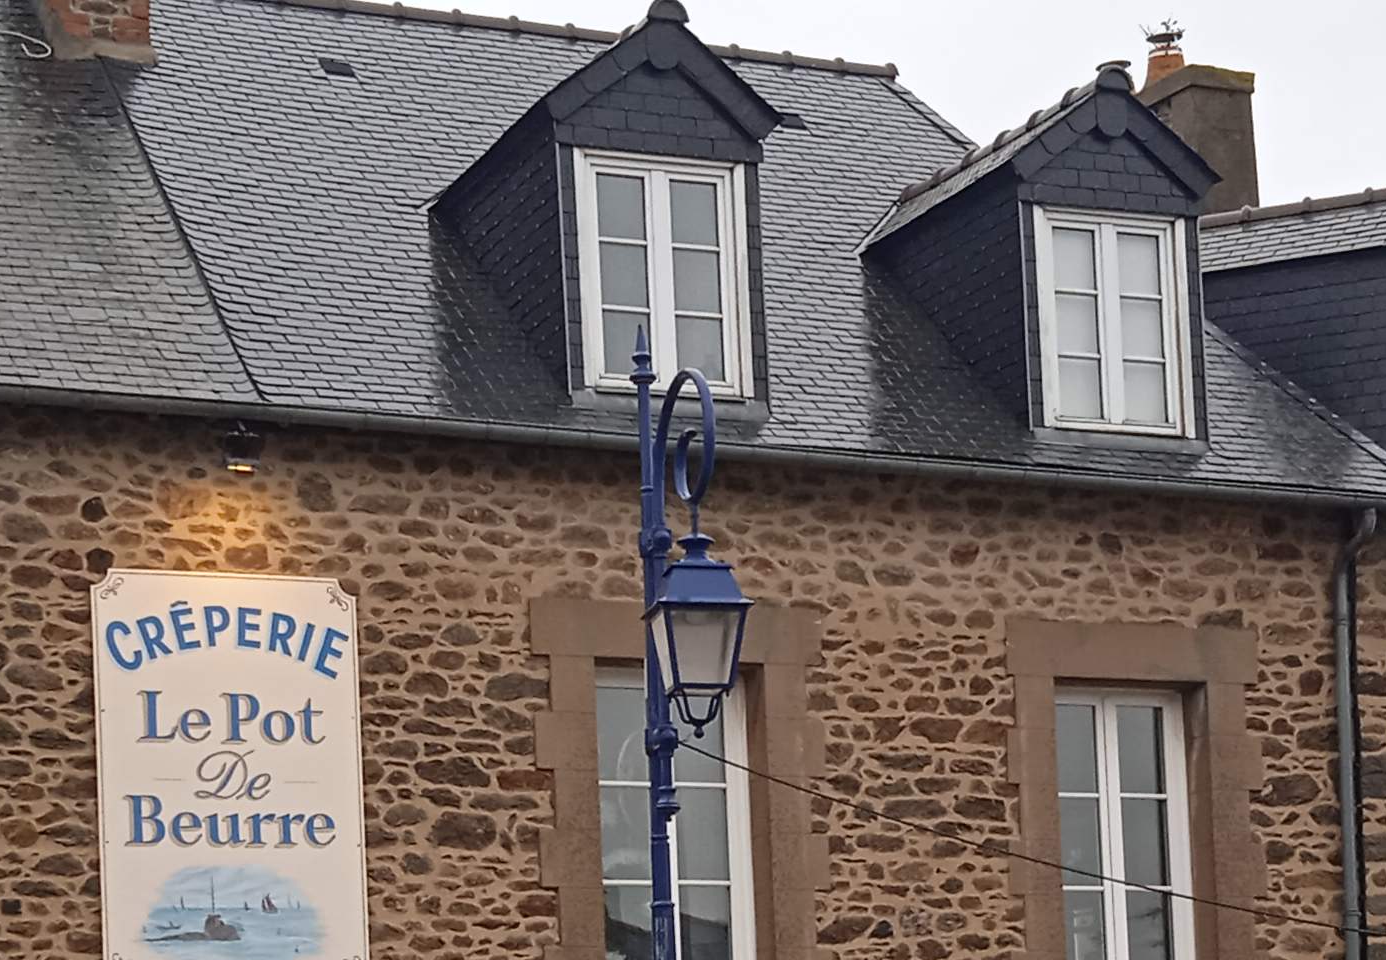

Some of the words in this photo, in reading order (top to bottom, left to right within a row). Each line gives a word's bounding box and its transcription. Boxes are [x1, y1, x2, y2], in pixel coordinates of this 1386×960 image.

[105, 601, 350, 680] CRÊPERIE
[135, 690, 212, 744] Le
[219, 691, 326, 746] Pot
[194, 749, 273, 801] De
[122, 793, 337, 849] Beurre
